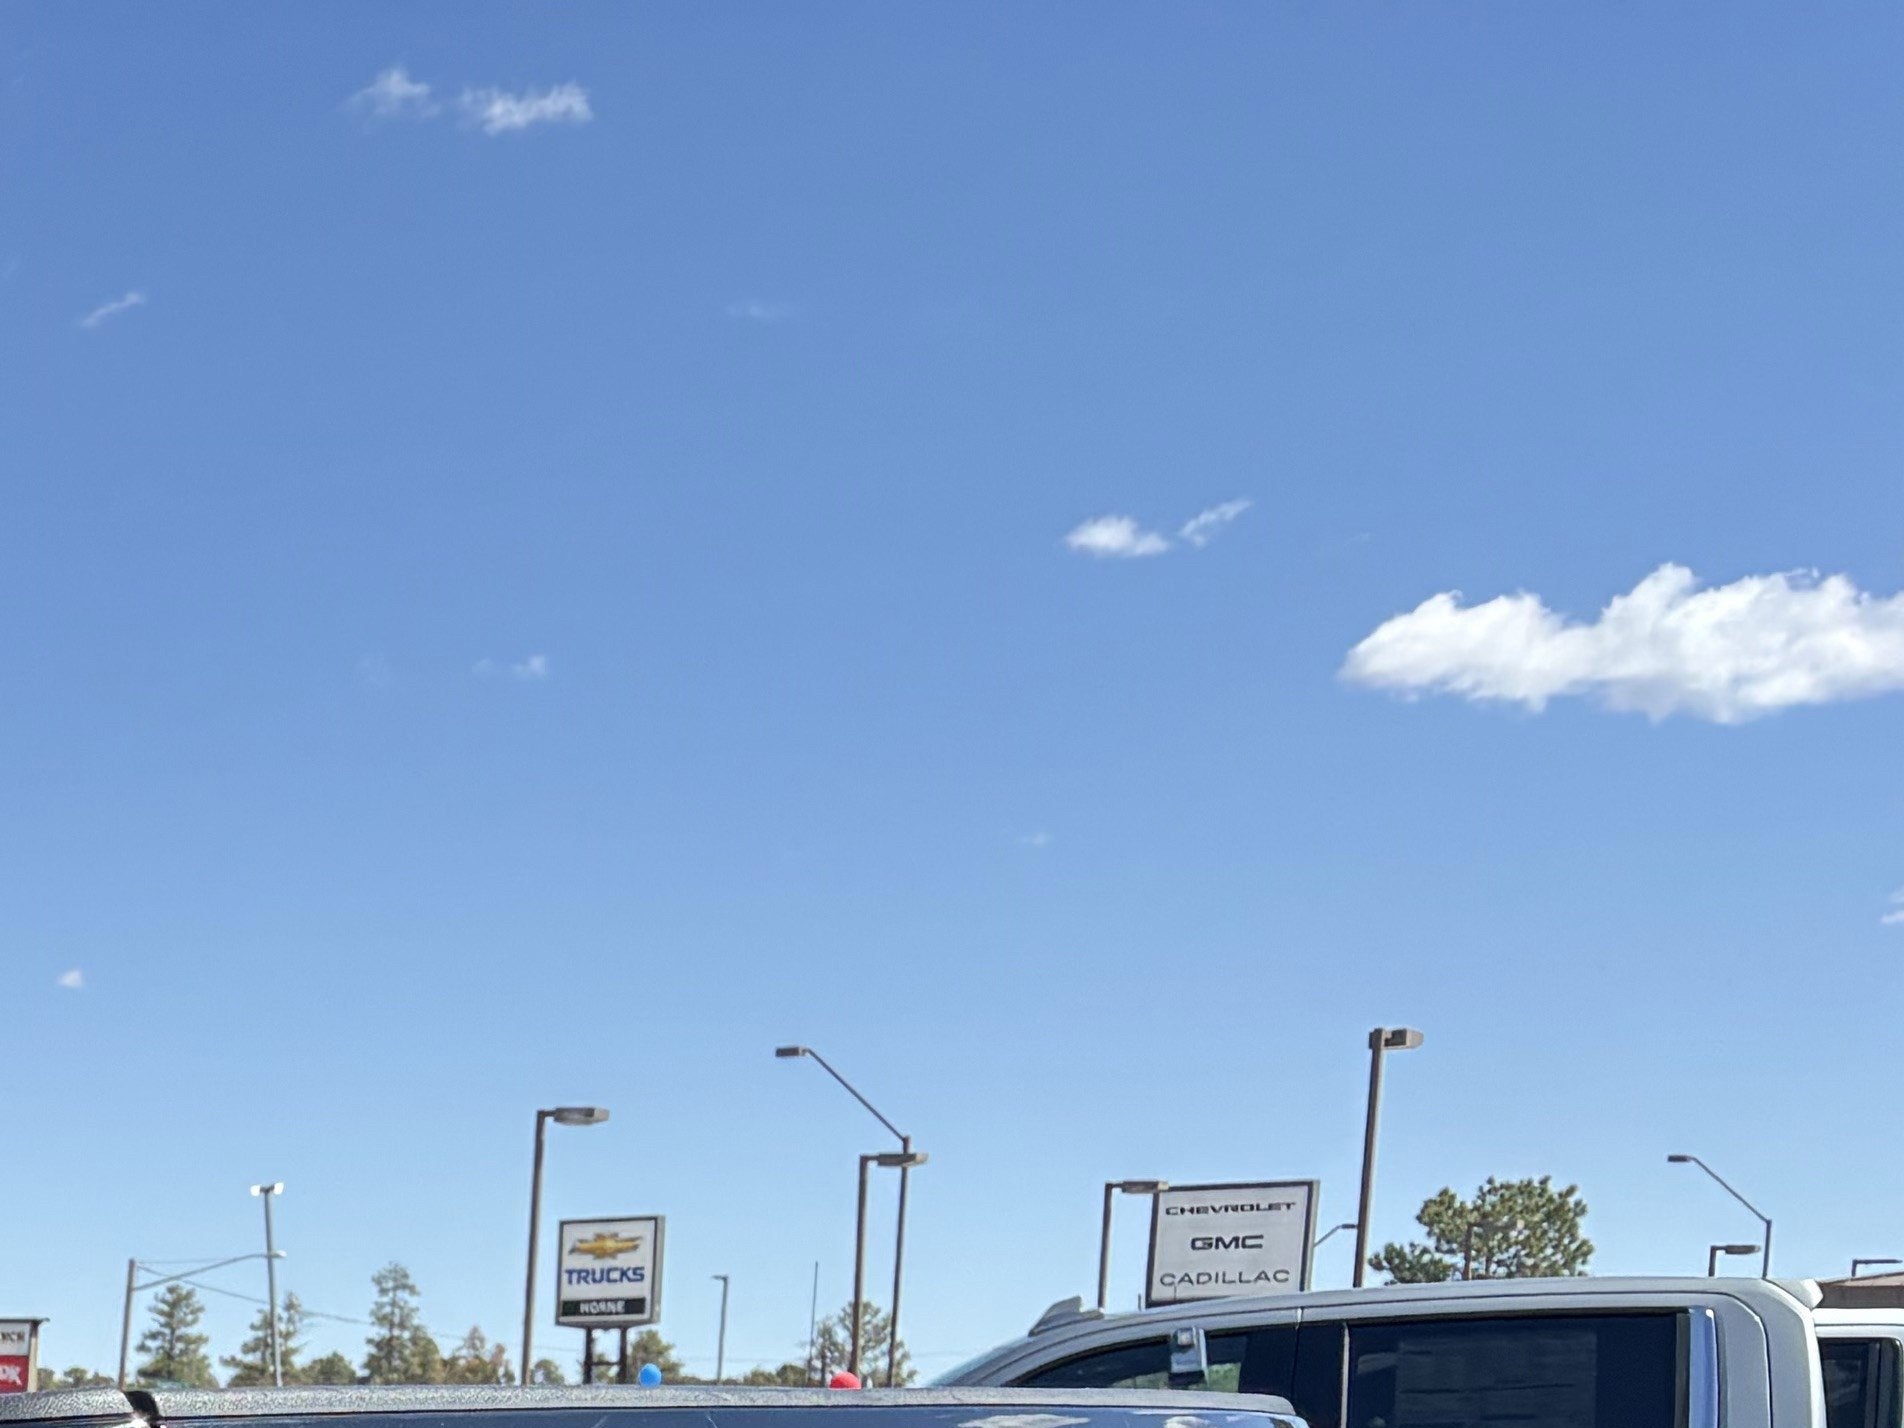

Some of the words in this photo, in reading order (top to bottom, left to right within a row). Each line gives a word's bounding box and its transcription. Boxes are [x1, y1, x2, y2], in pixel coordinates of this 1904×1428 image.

[1165, 1201, 1296, 1216] CHEVROLET
[1190, 1234, 1265, 1251] GMC
[565, 1266, 646, 1285] TRUCKS
[1159, 1268, 1291, 1287] CADILLAC
[579, 1300, 626, 1314] HORNE
